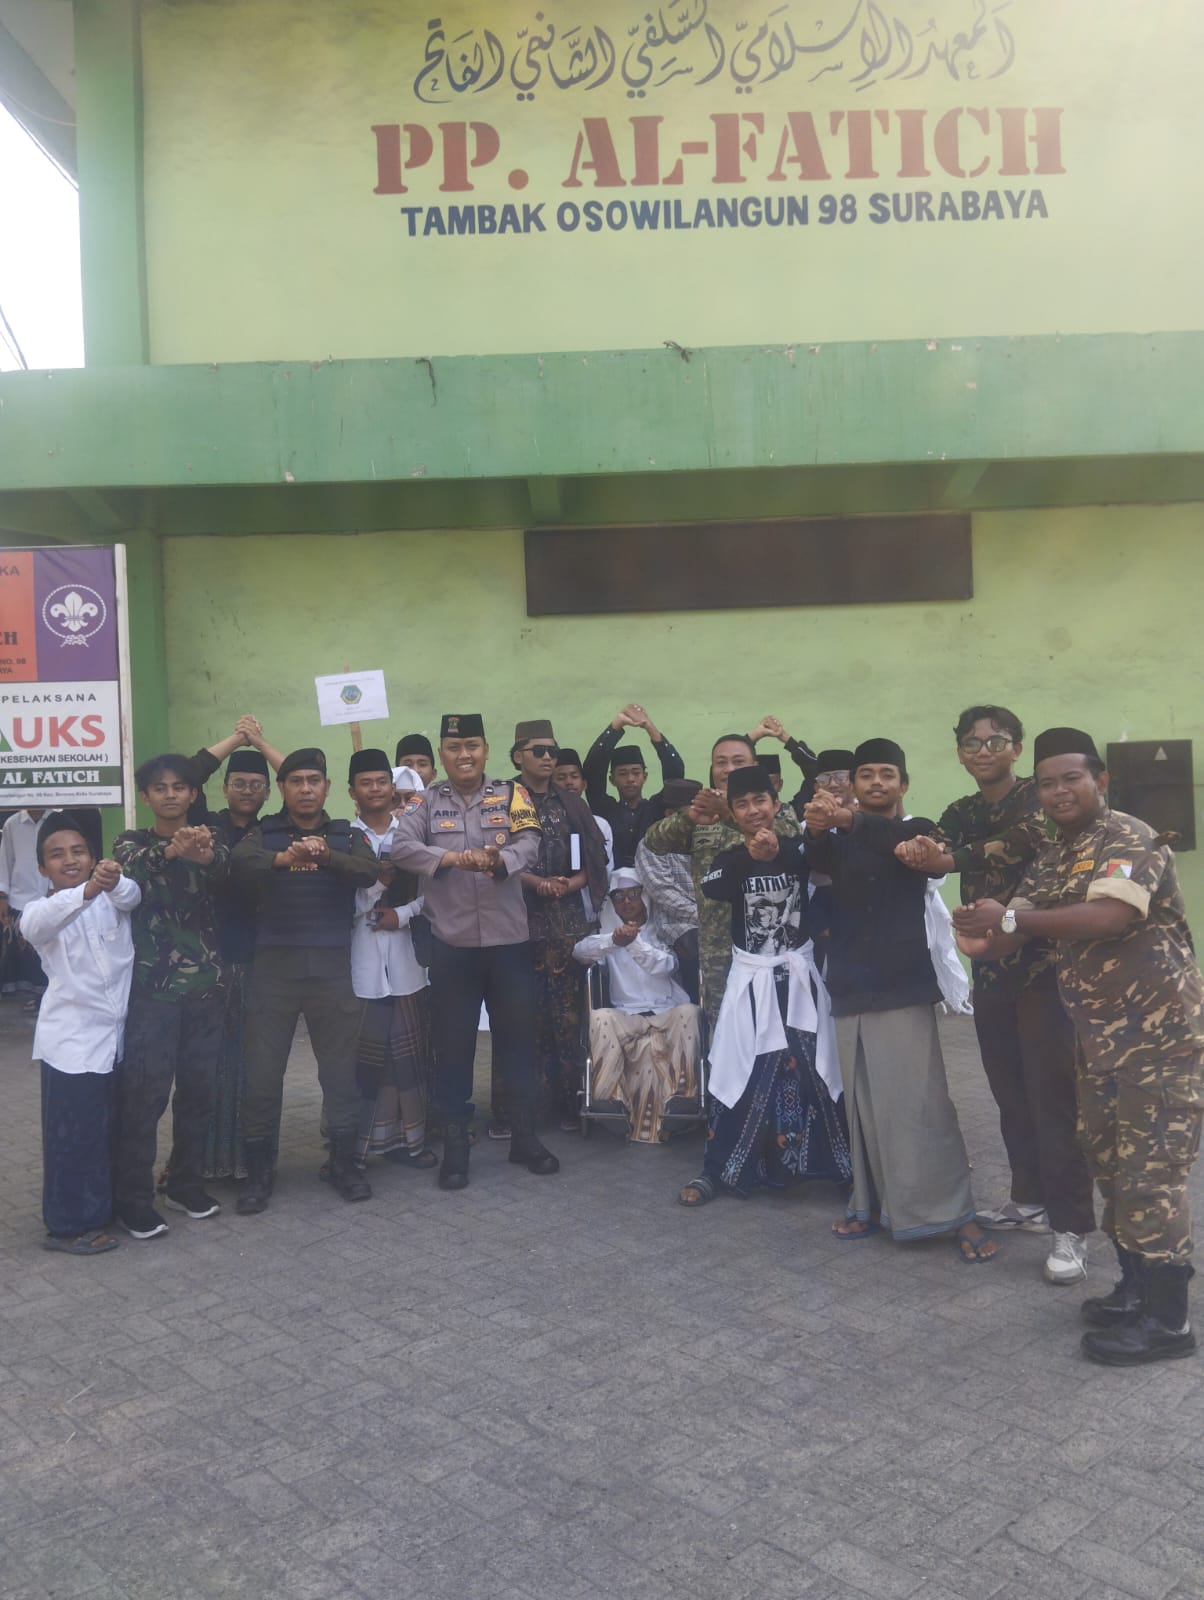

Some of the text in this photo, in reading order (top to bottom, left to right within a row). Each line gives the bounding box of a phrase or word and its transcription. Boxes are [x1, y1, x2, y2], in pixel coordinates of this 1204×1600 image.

[371, 107, 1067, 195] PP. AL-FATICH
[401, 189, 1049, 236] TAMBAK OSOWILANGUN 98 SURABAYA
[1, 693, 97, 704] PELAKSANA
[12, 714, 106, 749] UKS
[0, 754, 56, 764] KESEHATAN
[57, 753, 103, 763] SEKOLAH
[2, 770, 101, 785] AL FATICH
[433, 810, 460, 818] ARIF
